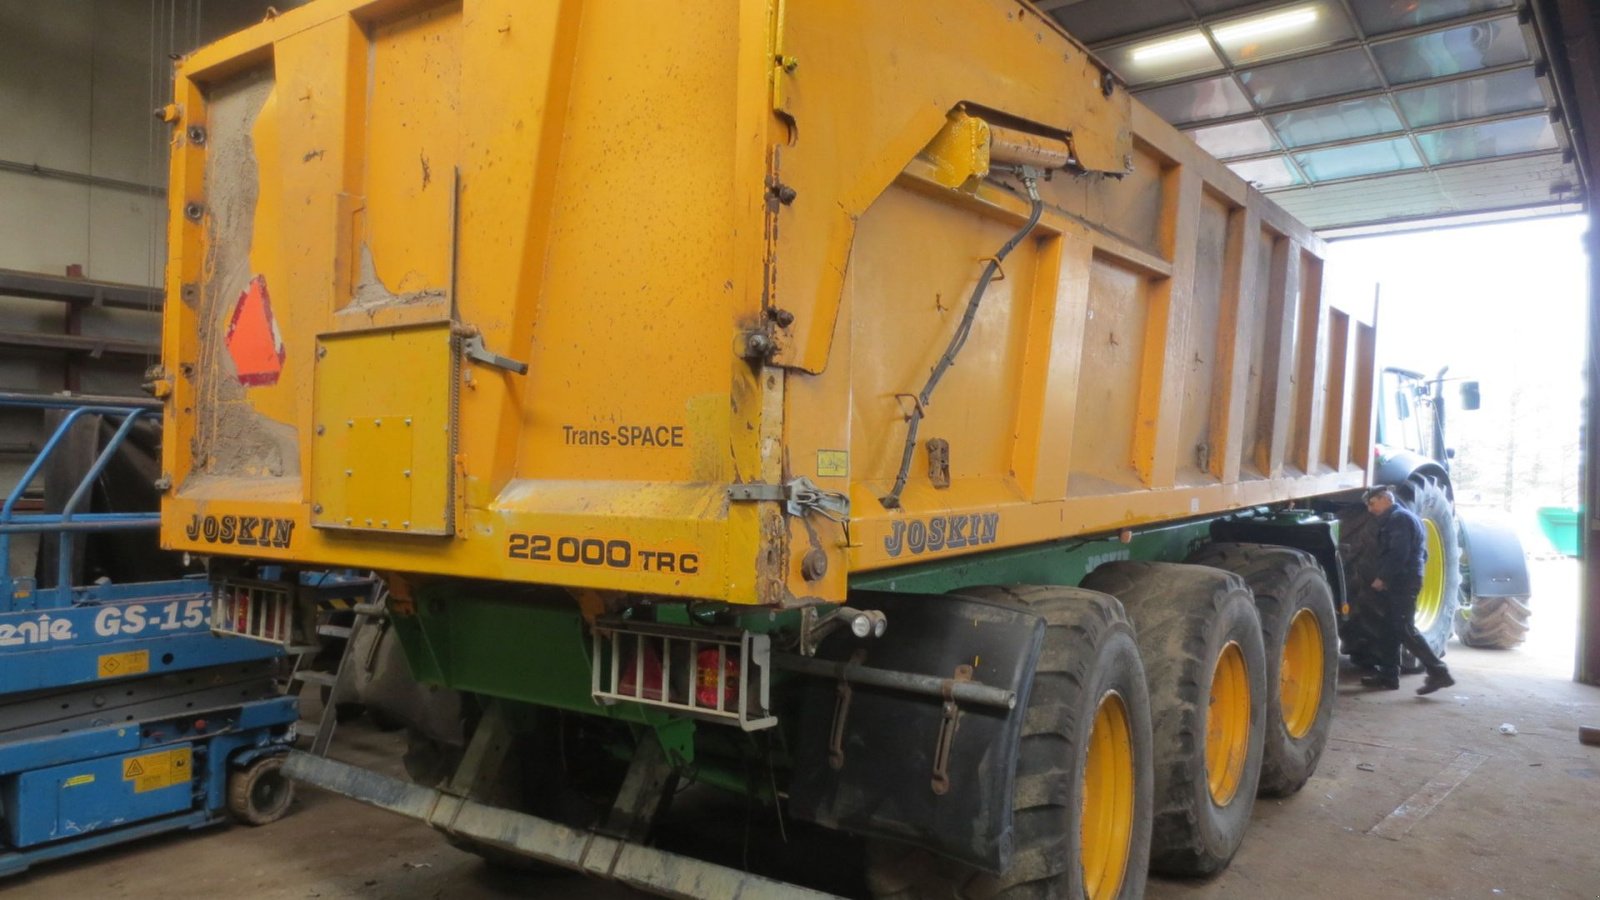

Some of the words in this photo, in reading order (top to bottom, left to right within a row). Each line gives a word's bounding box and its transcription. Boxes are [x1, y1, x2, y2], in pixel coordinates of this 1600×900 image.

[562, 425, 684, 447] Trans-SPACE
[186, 514, 296, 549] JOSKIN
[884, 512, 999, 557] JOSKIN
[638, 550, 698, 574] TRC
[0, 613, 73, 647] enie
